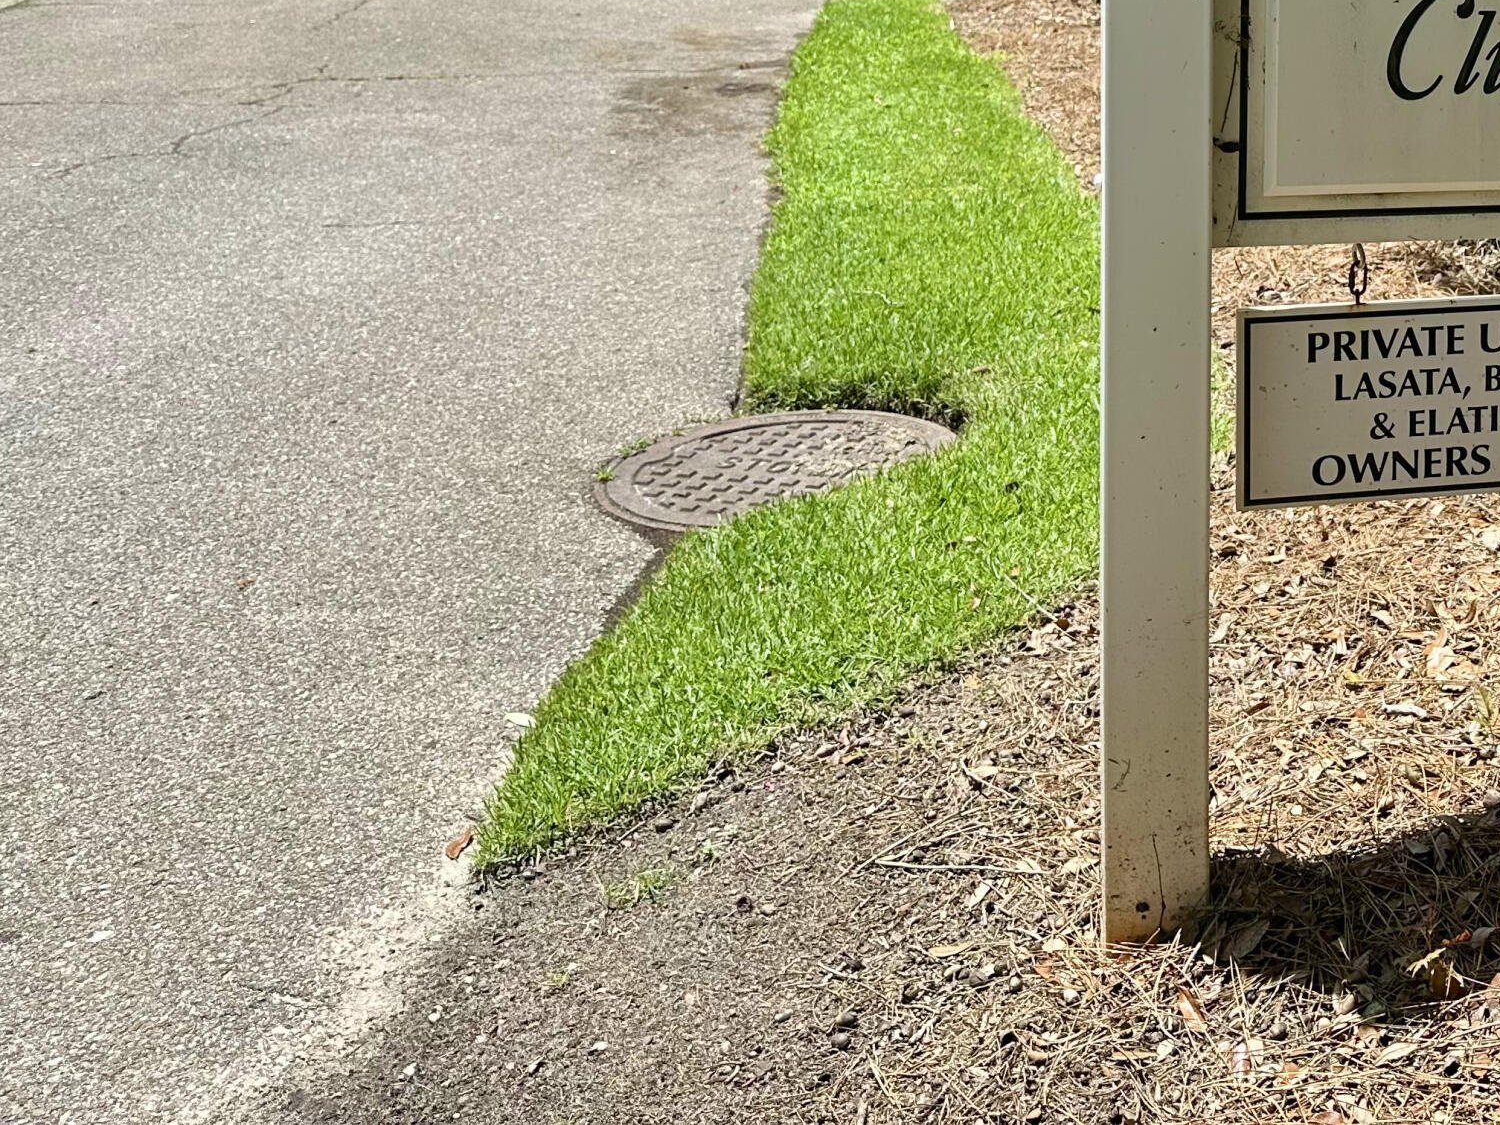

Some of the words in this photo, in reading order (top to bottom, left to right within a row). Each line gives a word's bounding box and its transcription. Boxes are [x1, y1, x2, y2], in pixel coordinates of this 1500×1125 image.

[1307, 324, 1465, 364] PRIVATE
[1334, 367, 1471, 401] LASATA,
[1369, 412, 1396, 440] &
[1312, 444, 1491, 486] OWNERS
